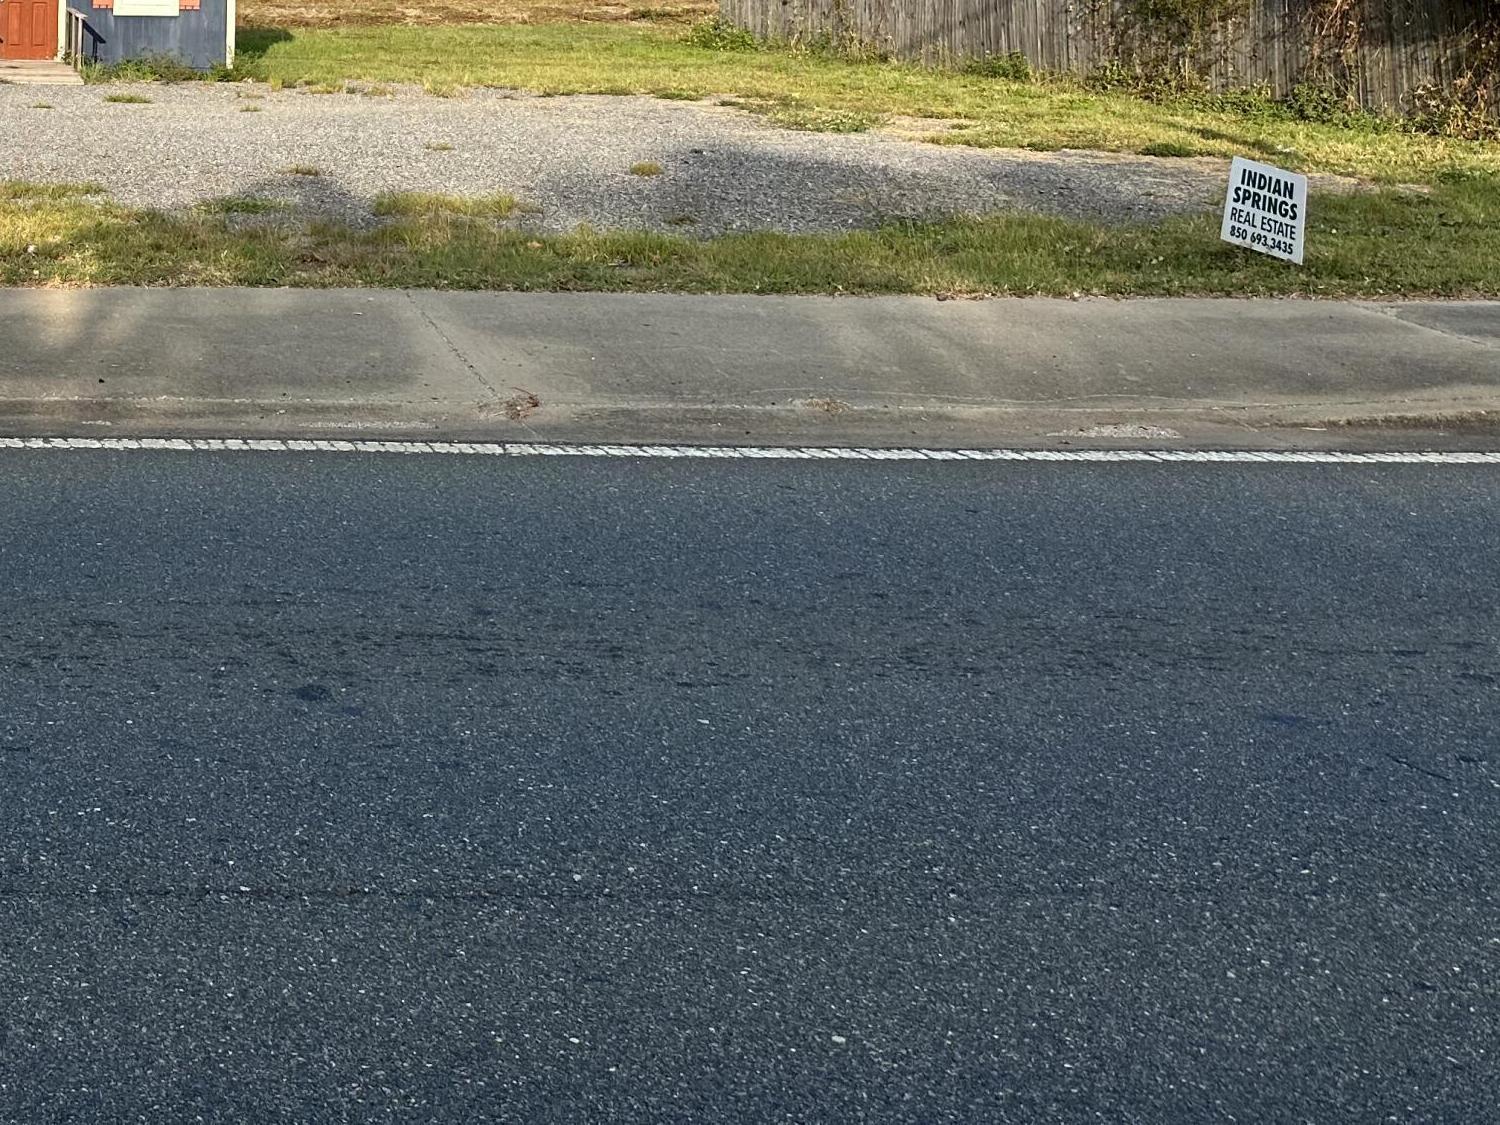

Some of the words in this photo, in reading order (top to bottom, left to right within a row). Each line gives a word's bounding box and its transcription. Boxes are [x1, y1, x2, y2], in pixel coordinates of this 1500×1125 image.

[1241, 168, 1294, 200] INDIAN
[1233, 186, 1298, 221] SPRINGS
[1230, 207, 1257, 228] REAL
[1260, 216, 1296, 241] ESTATE
[1230, 225, 1247, 240] 850
[1250, 232, 1294, 255] 693.3435
